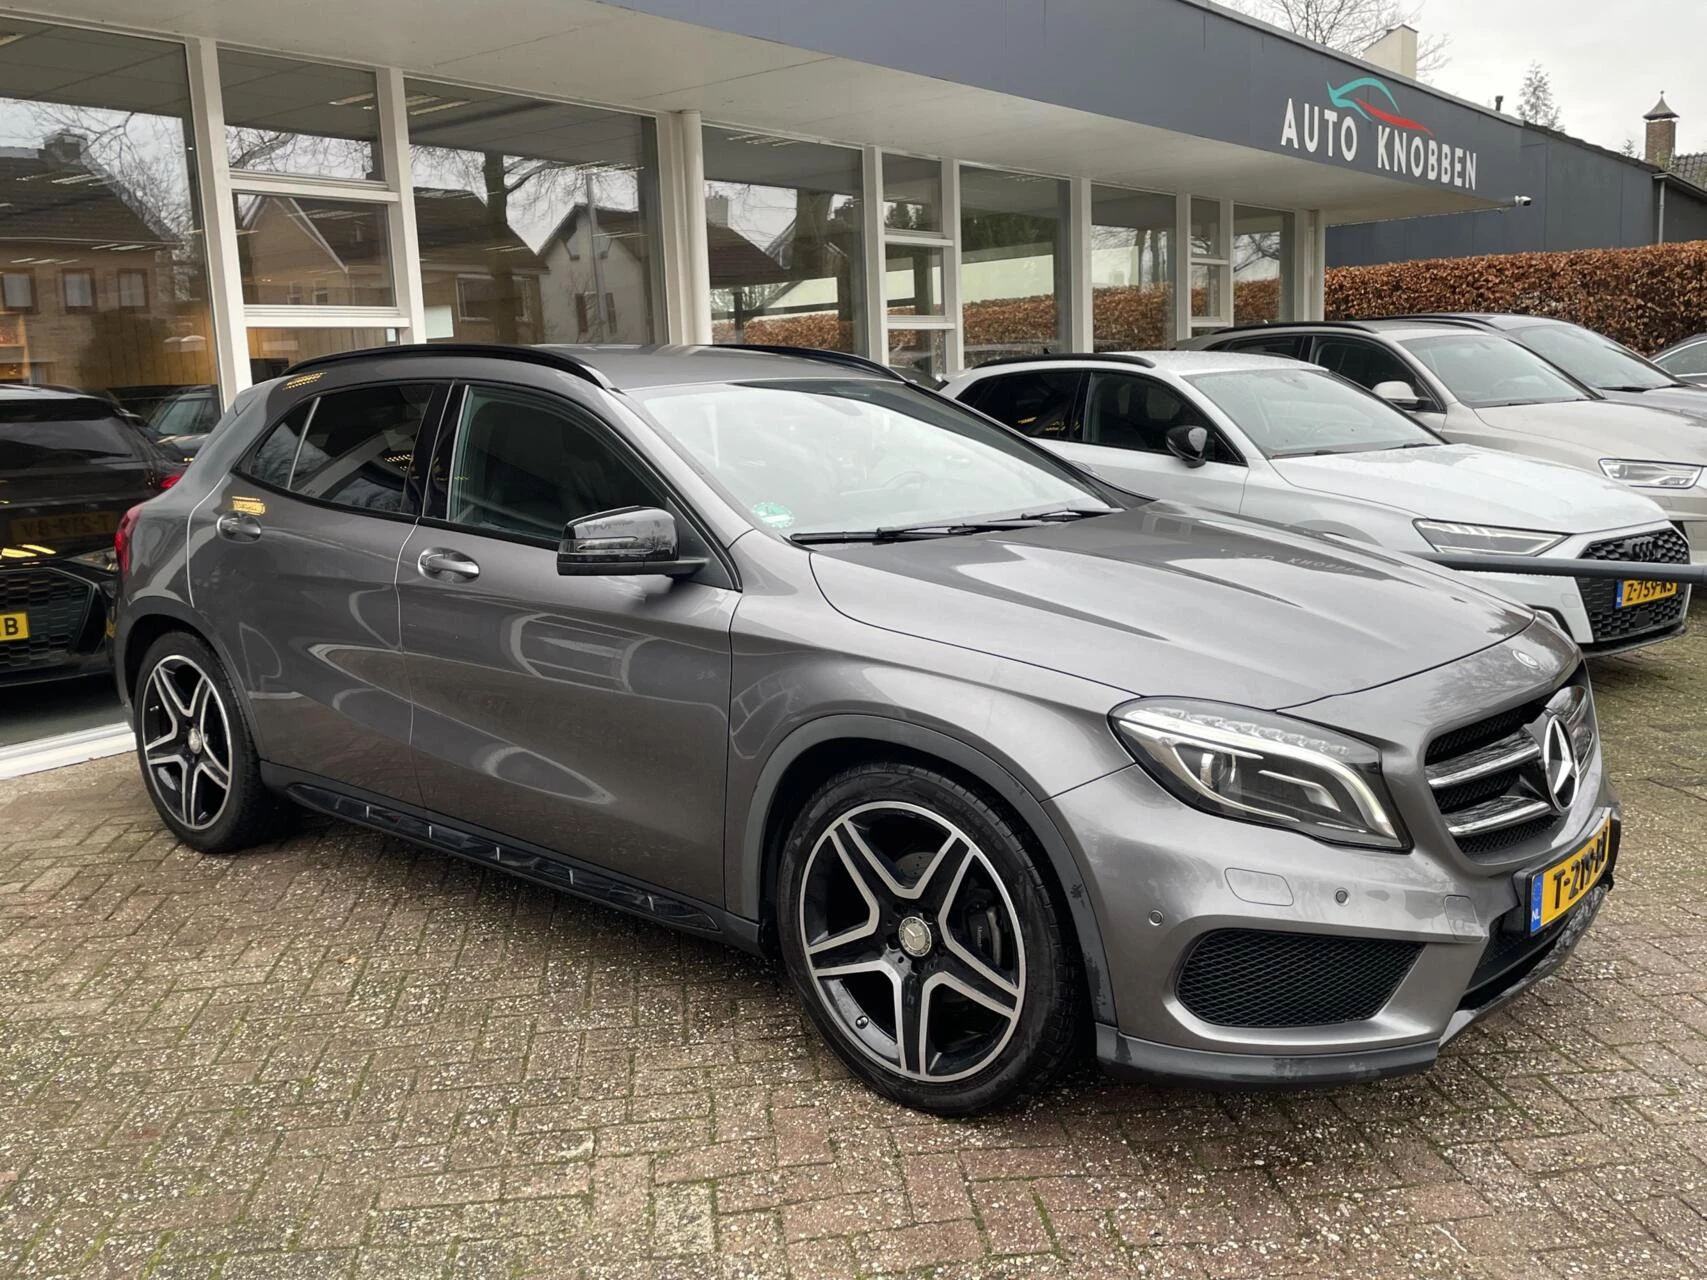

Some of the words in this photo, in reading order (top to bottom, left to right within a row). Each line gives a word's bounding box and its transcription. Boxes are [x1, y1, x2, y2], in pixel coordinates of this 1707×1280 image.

[1281, 98, 1357, 161] AUTO
[1377, 125, 1477, 190] KNOBBEN
[1531, 909, 1541, 922] NL
